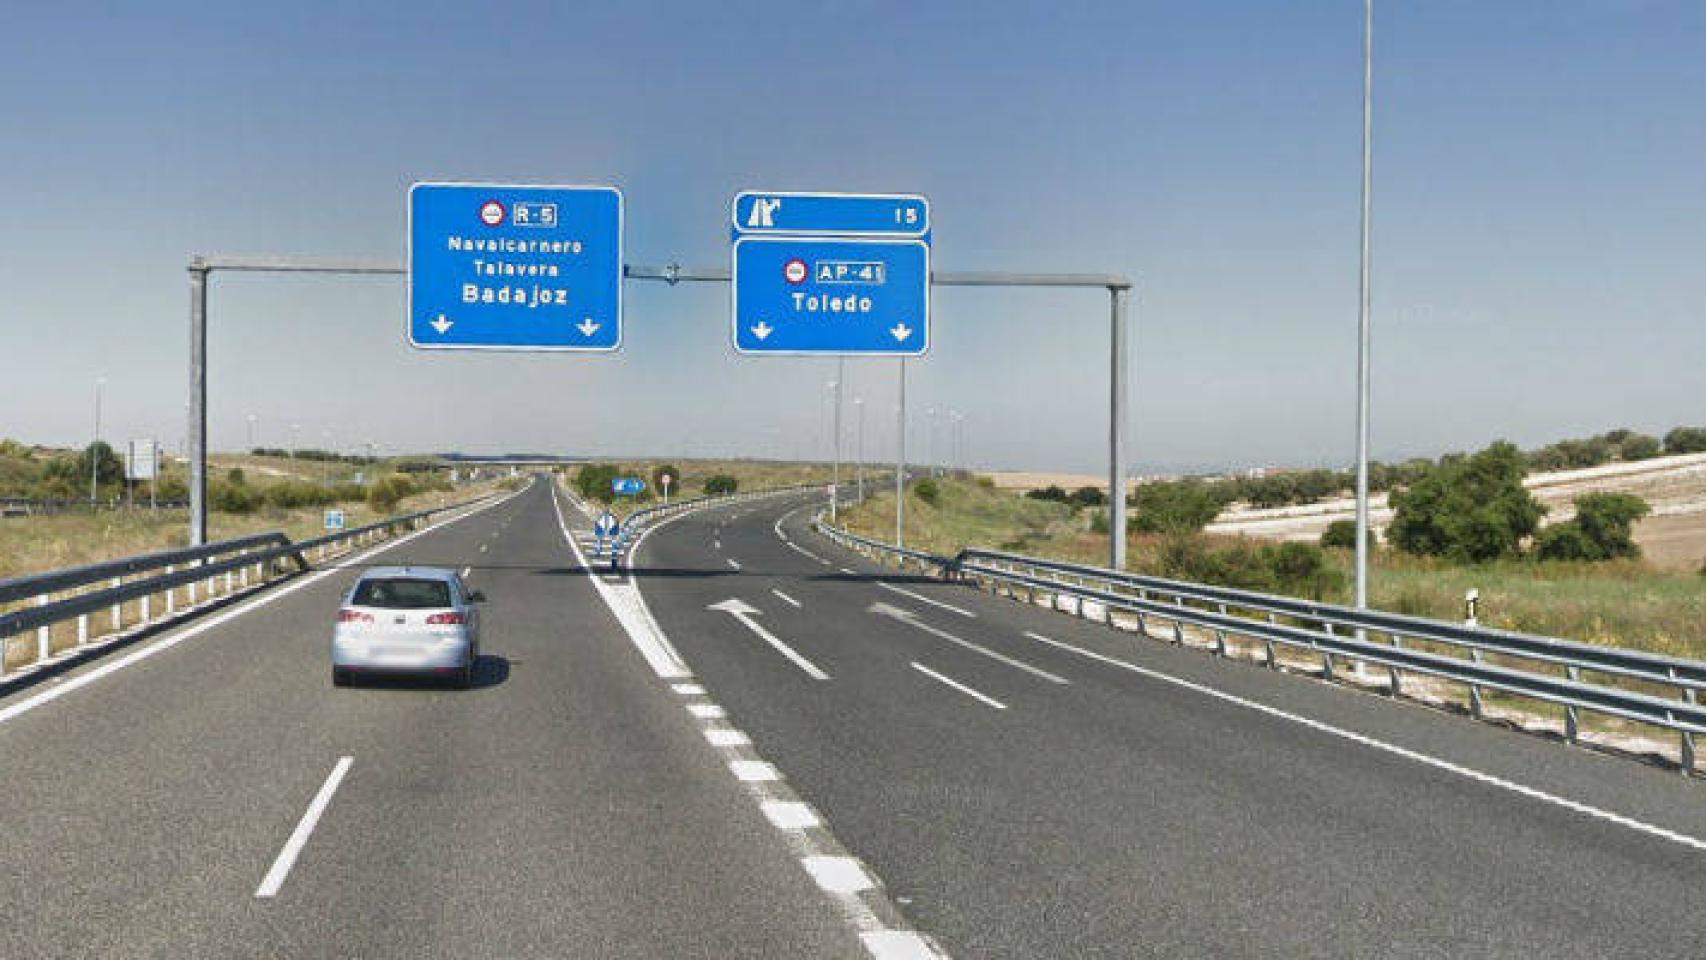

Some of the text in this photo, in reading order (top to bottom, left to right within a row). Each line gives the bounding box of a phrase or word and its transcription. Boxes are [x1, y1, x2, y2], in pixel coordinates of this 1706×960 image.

[516, 205, 553, 223] R-5
[894, 207, 918, 224] 15
[448, 236, 583, 253] Navalcarnero
[473, 258, 559, 277] Talavera
[819, 264, 883, 280] AP-41
[461, 283, 568, 308] Badajoz
[791, 292, 872, 313] Toledo
